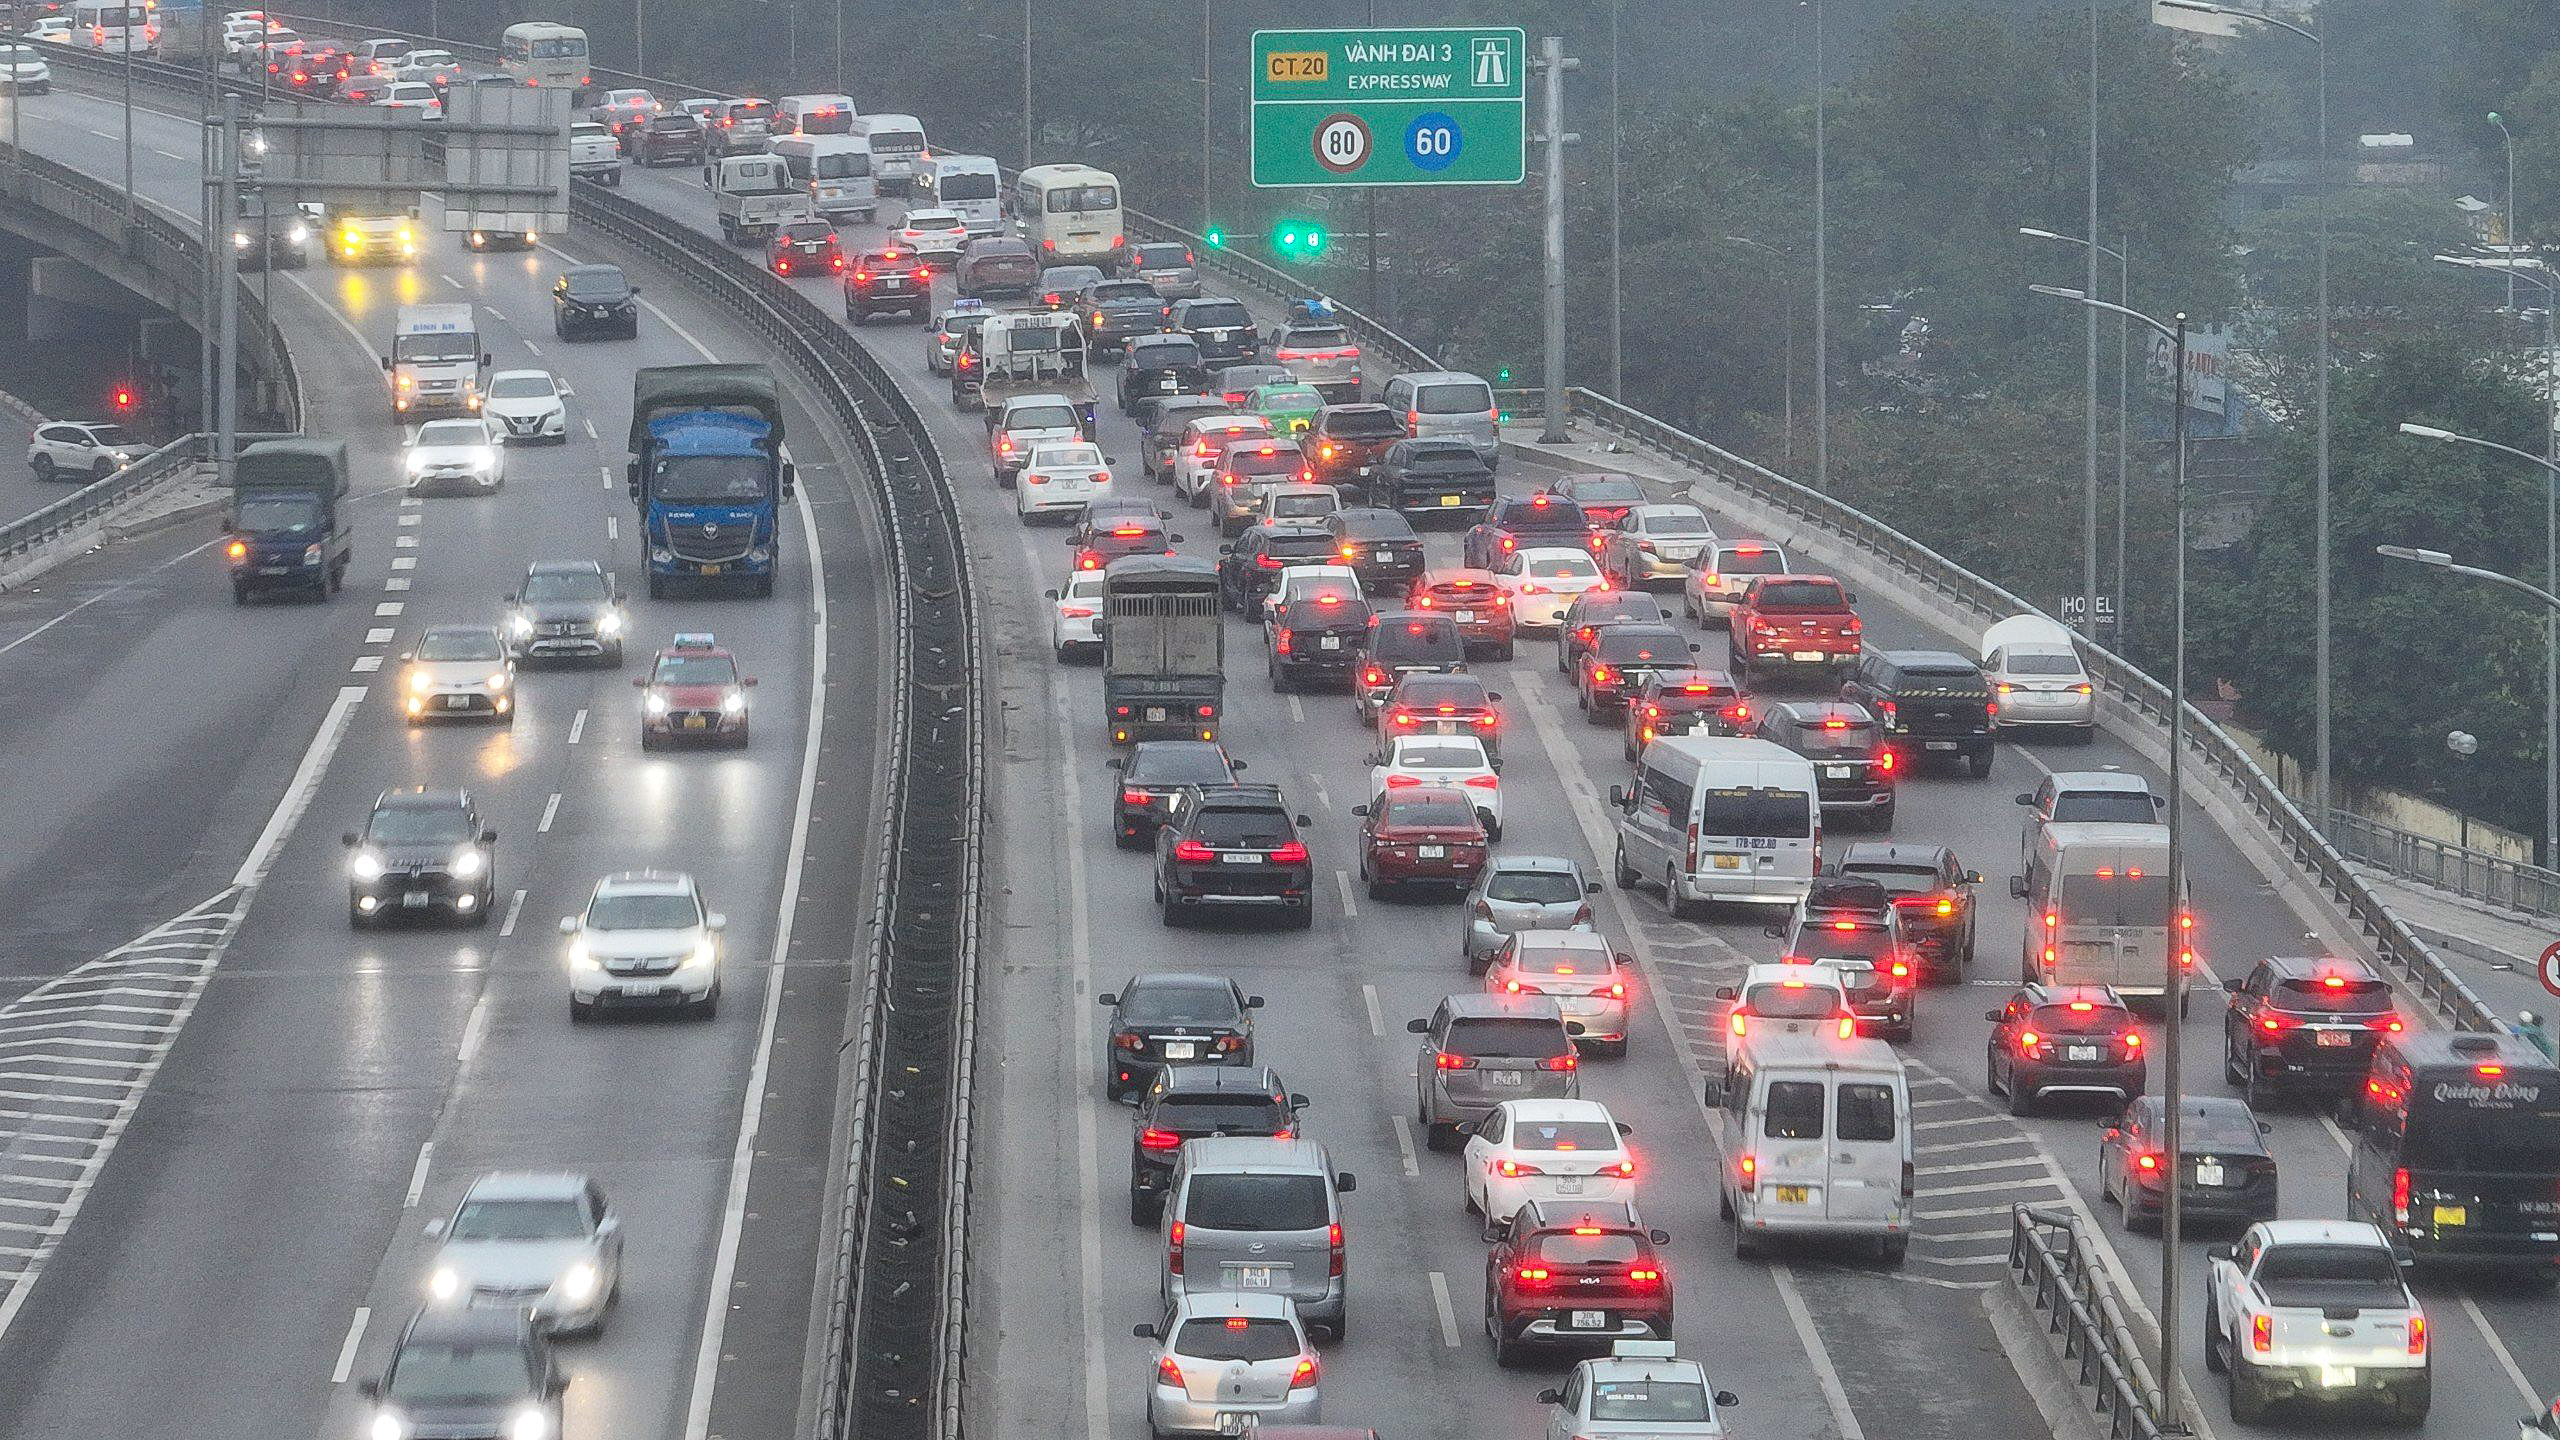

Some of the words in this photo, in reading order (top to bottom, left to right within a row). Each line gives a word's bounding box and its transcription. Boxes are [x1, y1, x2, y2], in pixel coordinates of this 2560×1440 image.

[1344, 40, 1397, 62] VÀNH
[1402, 44, 1435, 62] ĐAI
[1440, 44, 1452, 62] 3
[1271, 58, 1324, 76] CT.20
[1348, 74, 1452, 89] EXPRESSWAY
[1329, 130, 1355, 155] 80
[1416, 128, 1451, 155] 60
[2065, 596, 2114, 613] HOEL
